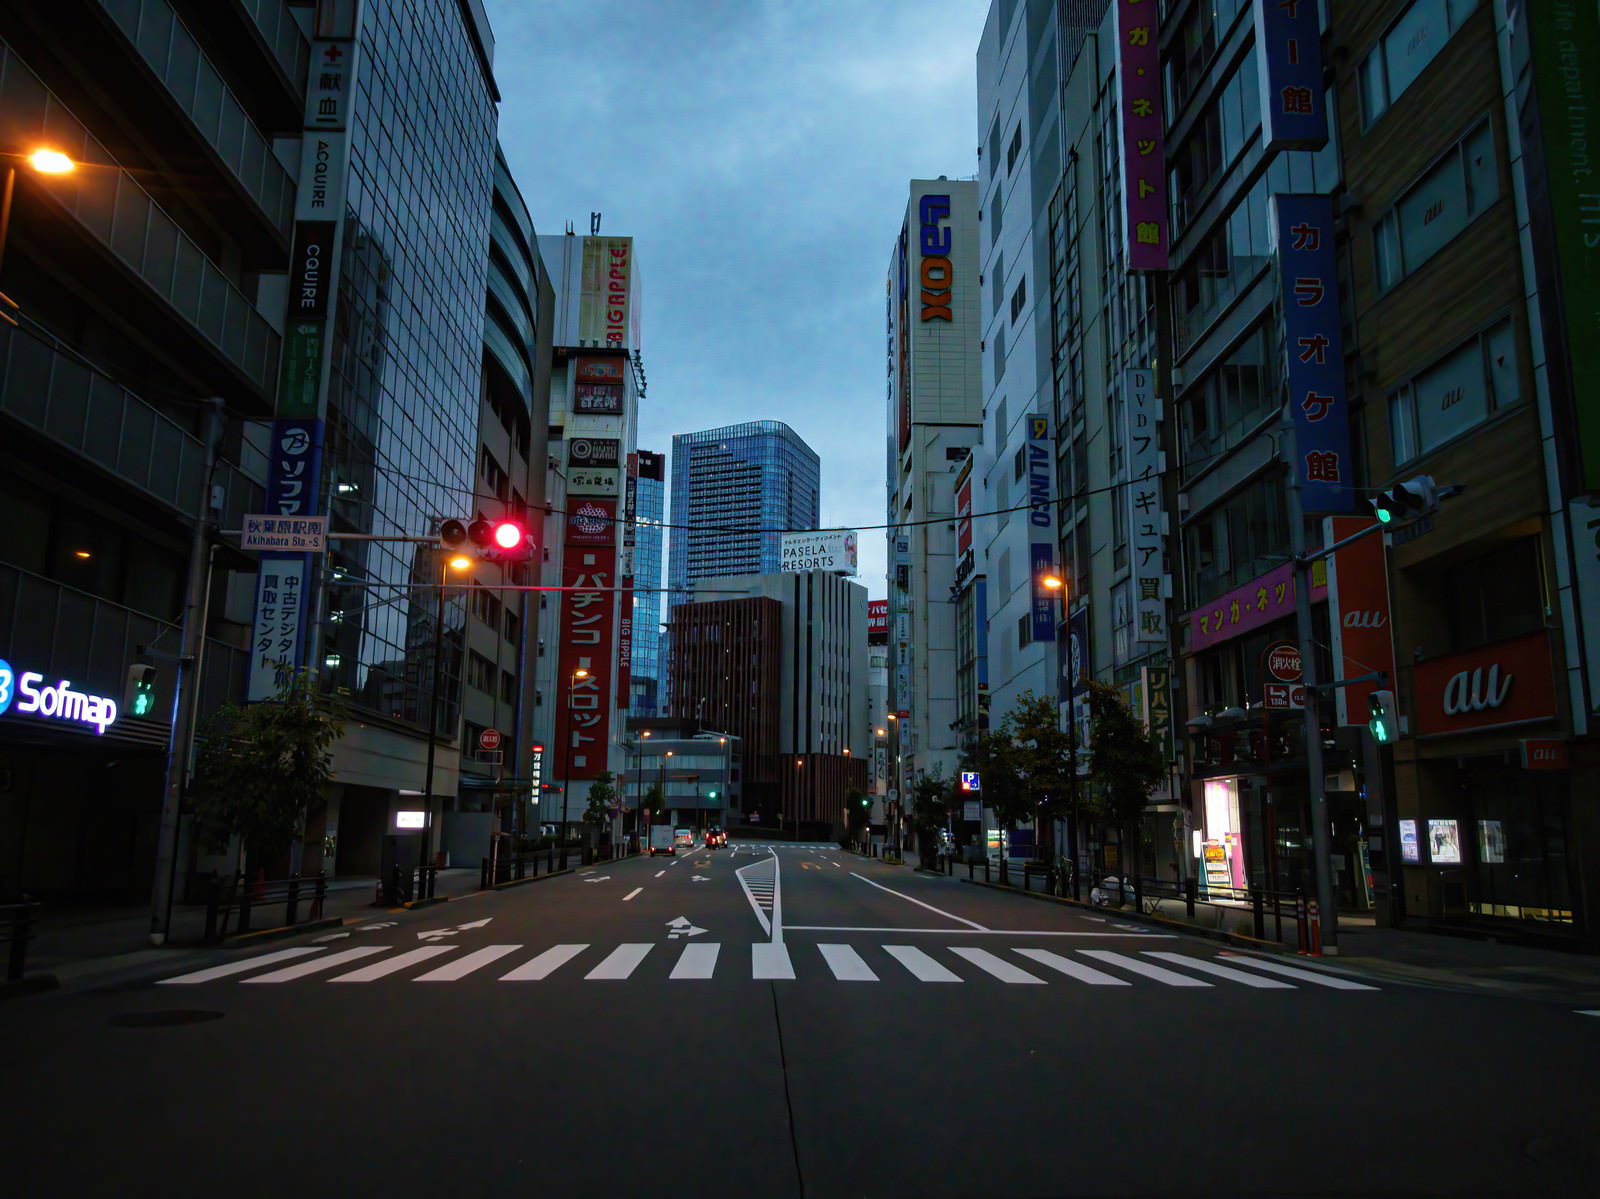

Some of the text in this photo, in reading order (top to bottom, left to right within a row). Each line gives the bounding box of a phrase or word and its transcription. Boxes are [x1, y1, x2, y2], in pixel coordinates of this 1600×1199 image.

[1128, 0, 1161, 245] ガ・ネット館
[312, 140, 330, 209] ACQUIRE
[1290, 222, 1341, 484] カラオケ館
[1030, 444, 1051, 528] ALINCO
[246, 536, 289, 547] Akihabara
[247, 519, 322, 536] 秋葉原駅南
[783, 544, 826, 558] PASELA
[783, 556, 834, 571] RESORTS
[257, 574, 279, 669] 買取センター
[570, 572, 607, 645] パチンコ
[1343, 609, 1388, 629] au
[18, 672, 117, 734] Sofmap
[1442, 662, 1514, 717] au
[967, 773, 975, 783] P
